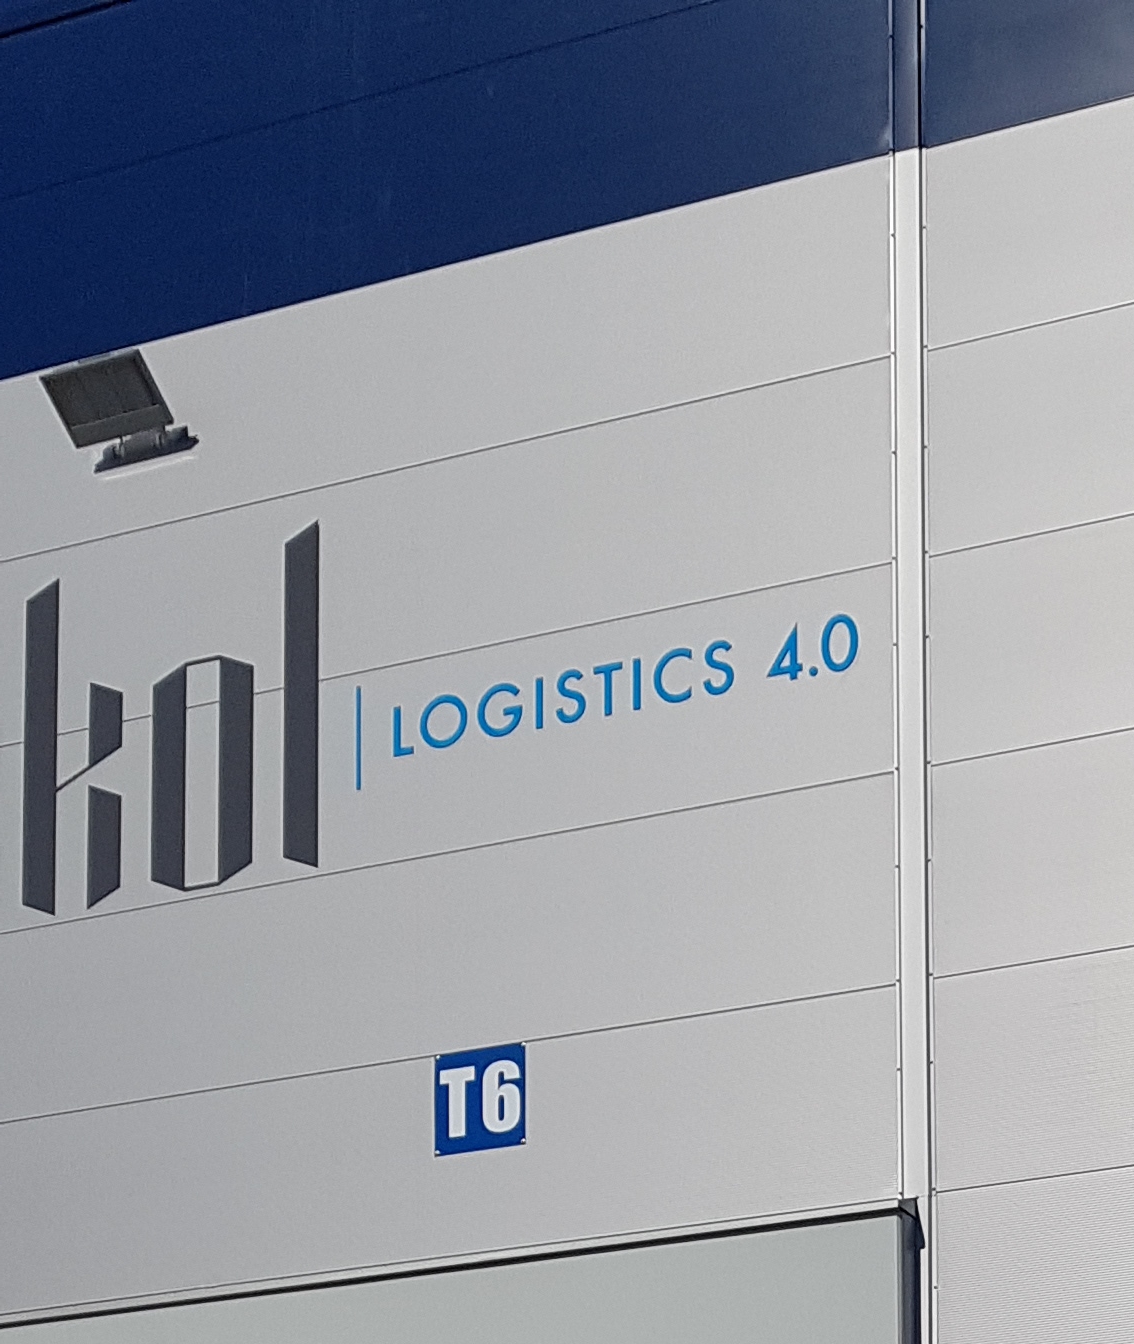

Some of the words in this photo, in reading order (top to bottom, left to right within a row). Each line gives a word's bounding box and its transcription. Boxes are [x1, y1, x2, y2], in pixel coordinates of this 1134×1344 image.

[392, 639, 736, 758] LOGISTICS
[766, 613, 860, 682] 4.0
[440, 1059, 521, 1139] T6
